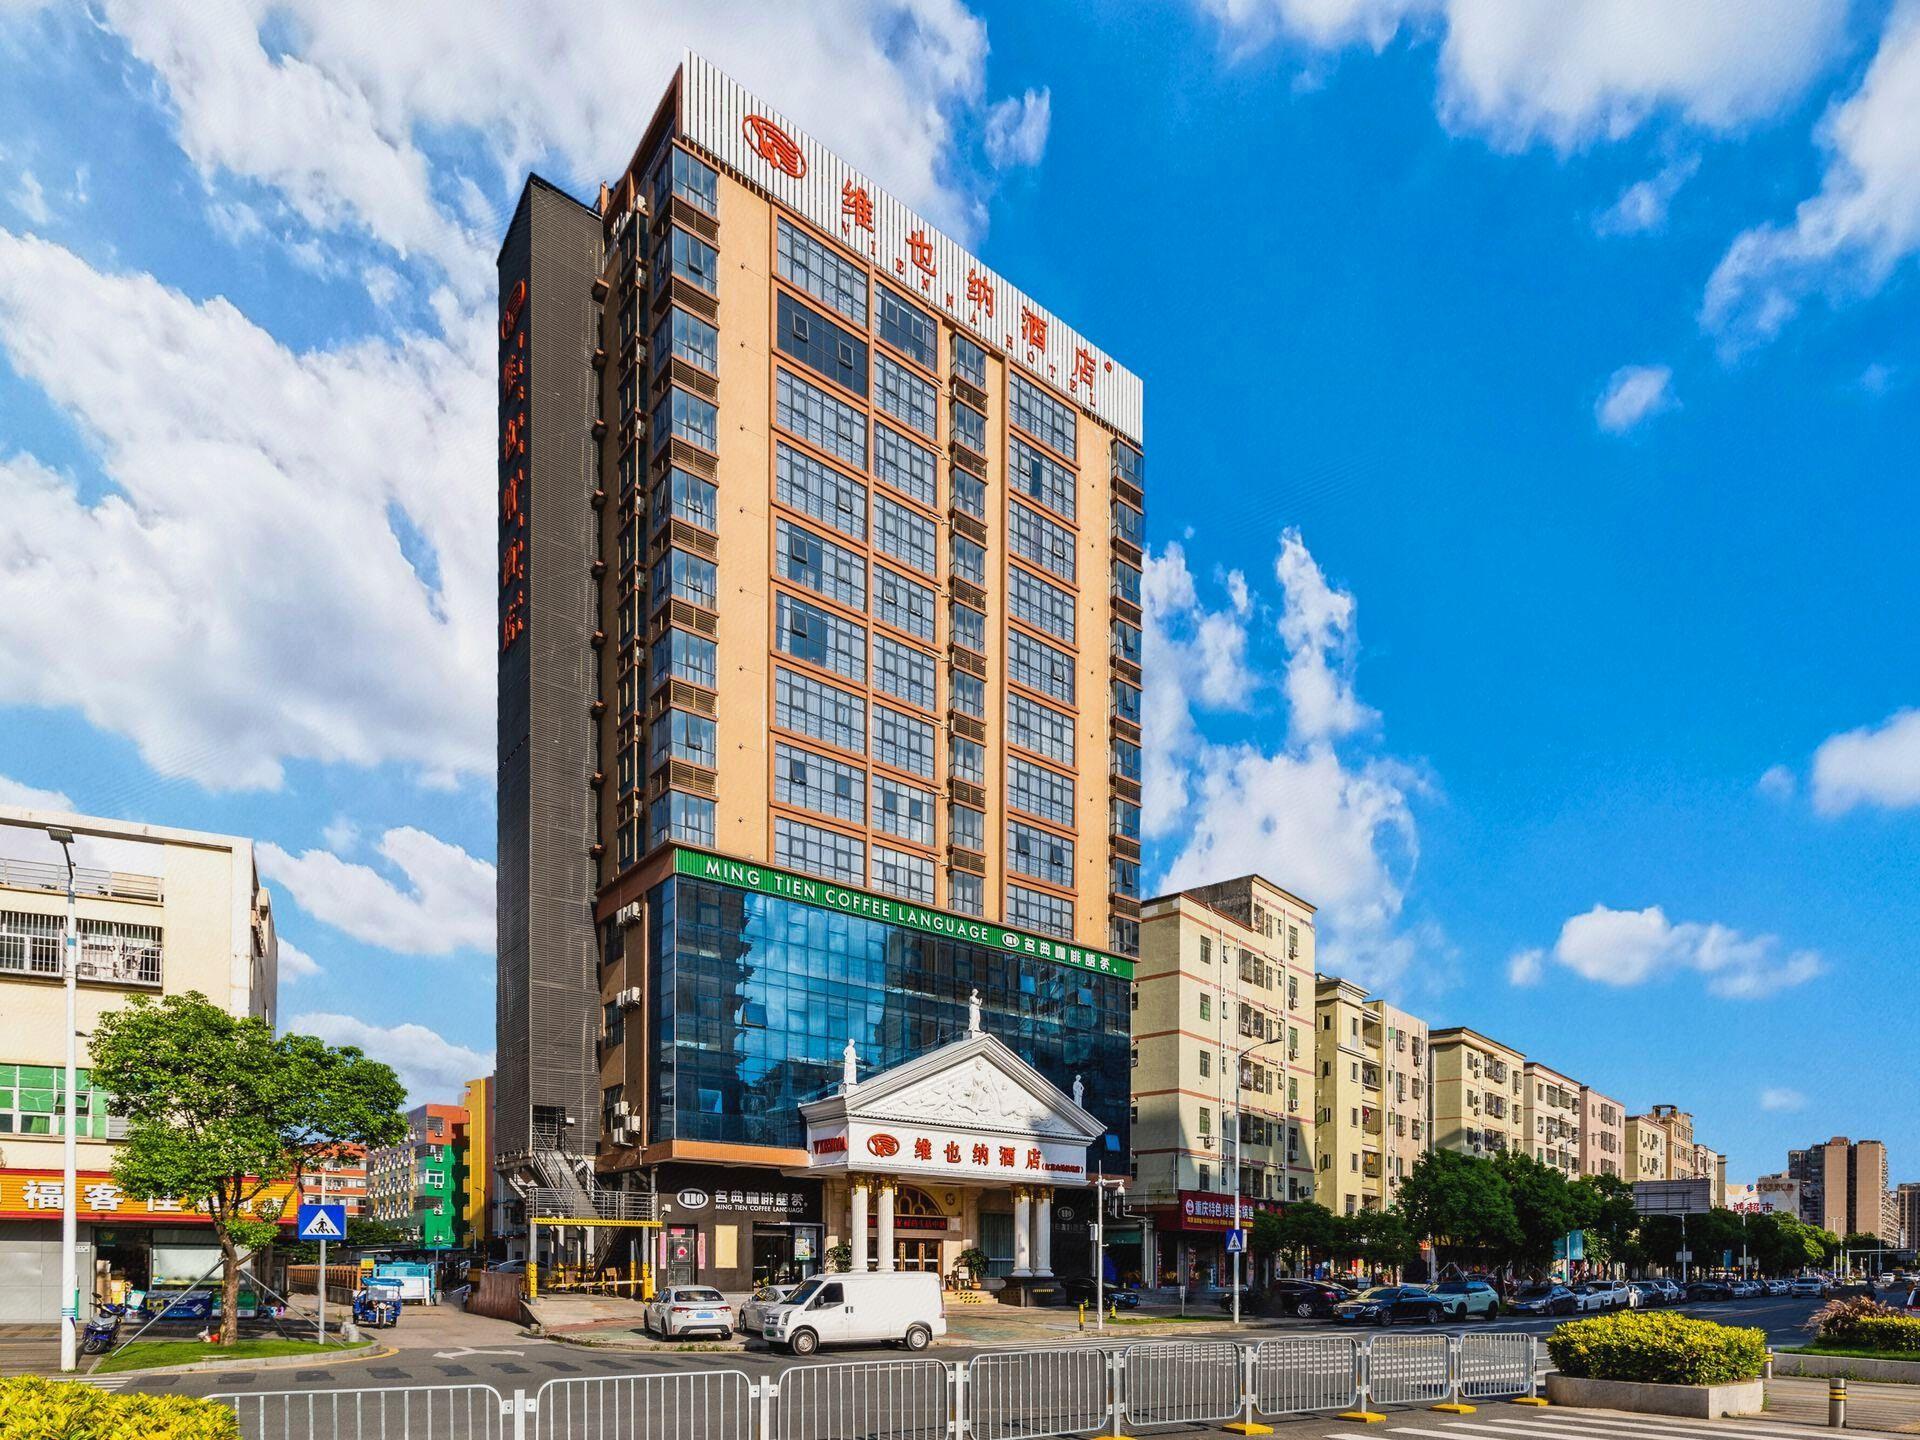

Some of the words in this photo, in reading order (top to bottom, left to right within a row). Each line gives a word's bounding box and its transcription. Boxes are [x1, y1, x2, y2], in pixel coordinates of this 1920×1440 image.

[842, 179, 1097, 389] 维也纳酒店
[842, 221, 978, 326] VIENNA
[1006, 334, 1096, 406] HOTEL
[705, 860, 761, 885] MING
[774, 876, 816, 898] TIEN
[825, 889, 890, 917] COFFEE
[898, 907, 988, 941] LANGUAGE
[914, 1137, 1042, 1170] 维也纳酒店
[734, 1204, 748, 1212] TIEN
[749, 1205, 771, 1213] COFFEE
[772, 1206, 804, 1214] LANGUAGE
